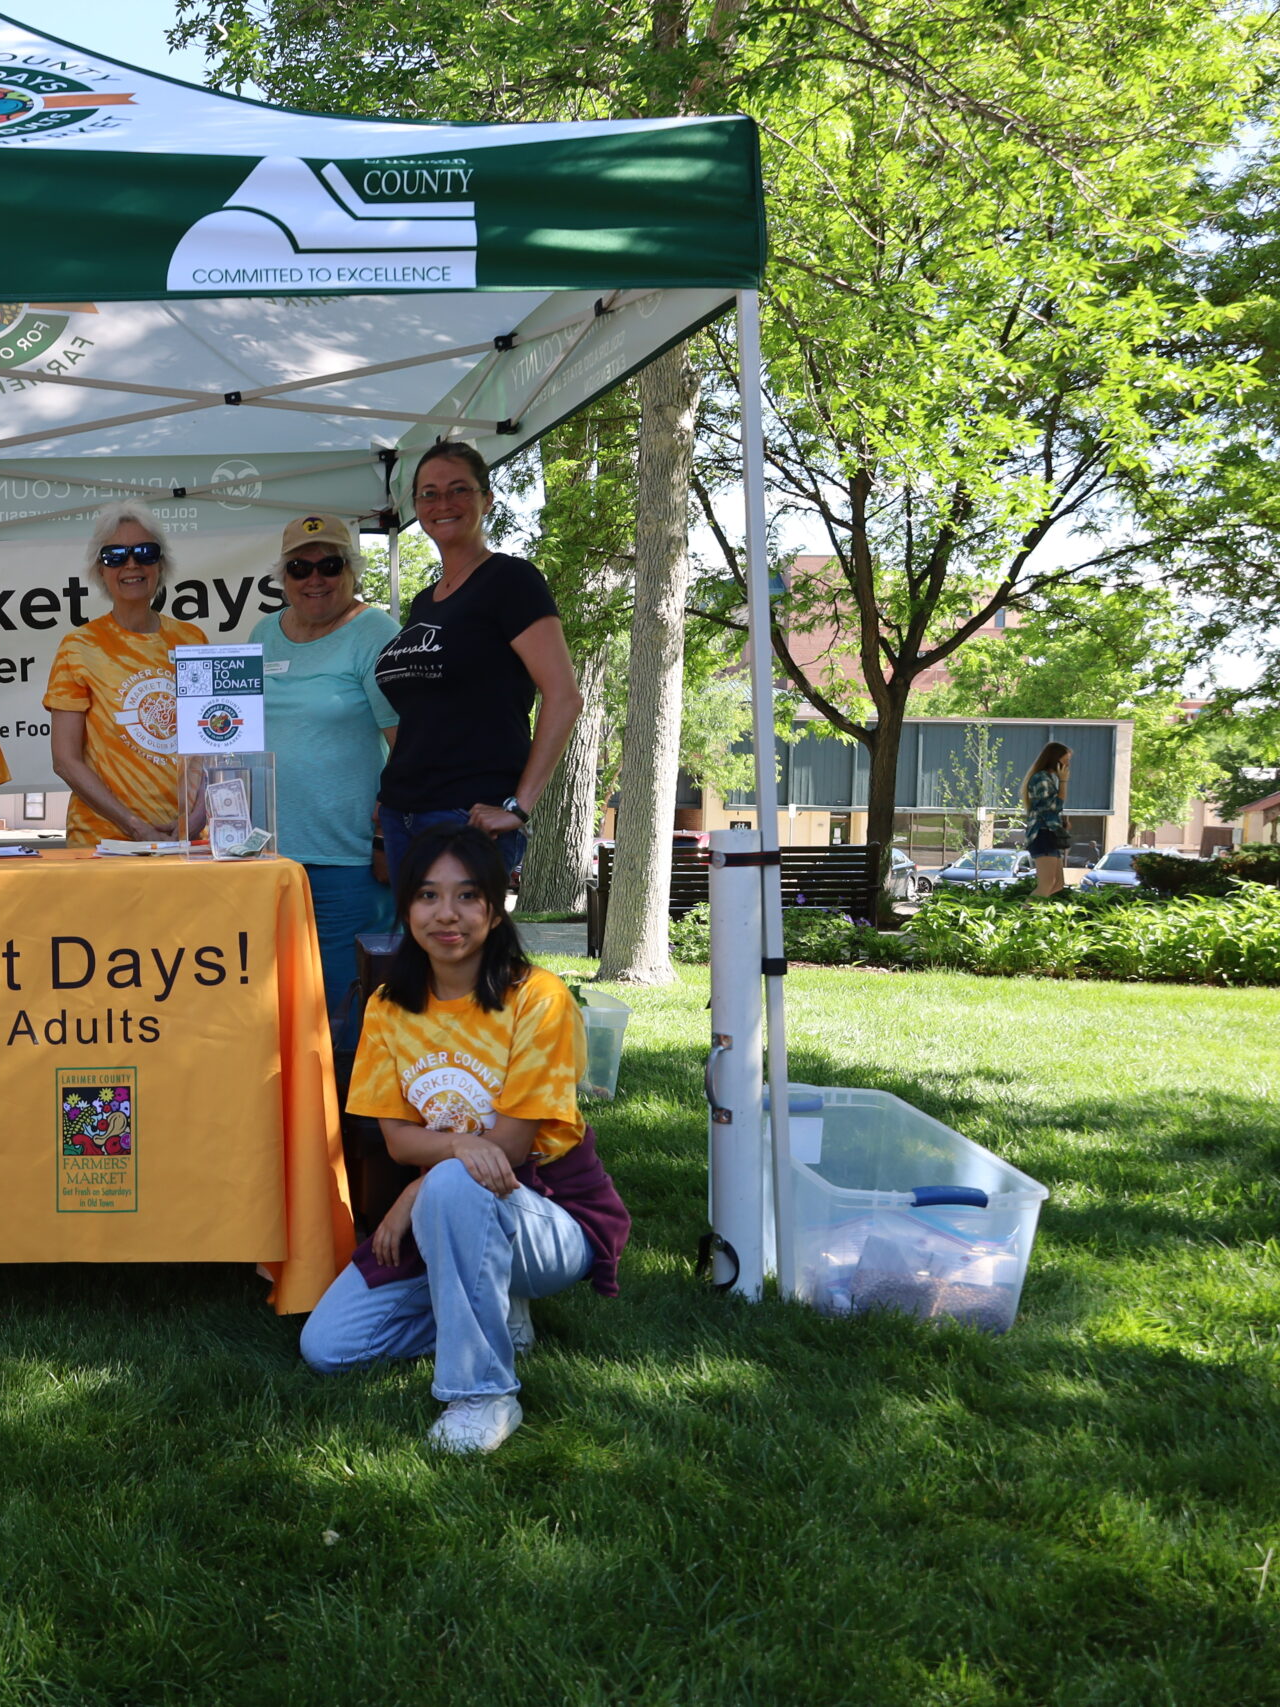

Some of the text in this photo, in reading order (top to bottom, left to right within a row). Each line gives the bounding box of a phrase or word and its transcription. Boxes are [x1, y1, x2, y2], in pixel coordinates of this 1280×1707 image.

[363, 168, 474, 196] COUNTY
[191, 265, 452, 284] COMMITTED TO EXCELLENCE
[150, 574, 289, 632] ays
[213, 659, 245, 670] SCAN
[213, 670, 230, 679] TO
[214, 678, 261, 689] DONATE
[114, 668, 153, 702] LARIMER
[128, 681, 161, 706] MARKET
[15, 720, 51, 738] Foo
[51, 931, 250, 1002] Days!
[7, 1008, 162, 1046] Adults
[61, 1074, 131, 1084] LARIMER COUNTY
[458, 1077, 489, 1110] DAYS
[62, 1156, 131, 1170] FARMERS'
[66, 1171, 128, 1185] MARKET
[87, 1198, 97, 1207] Old
